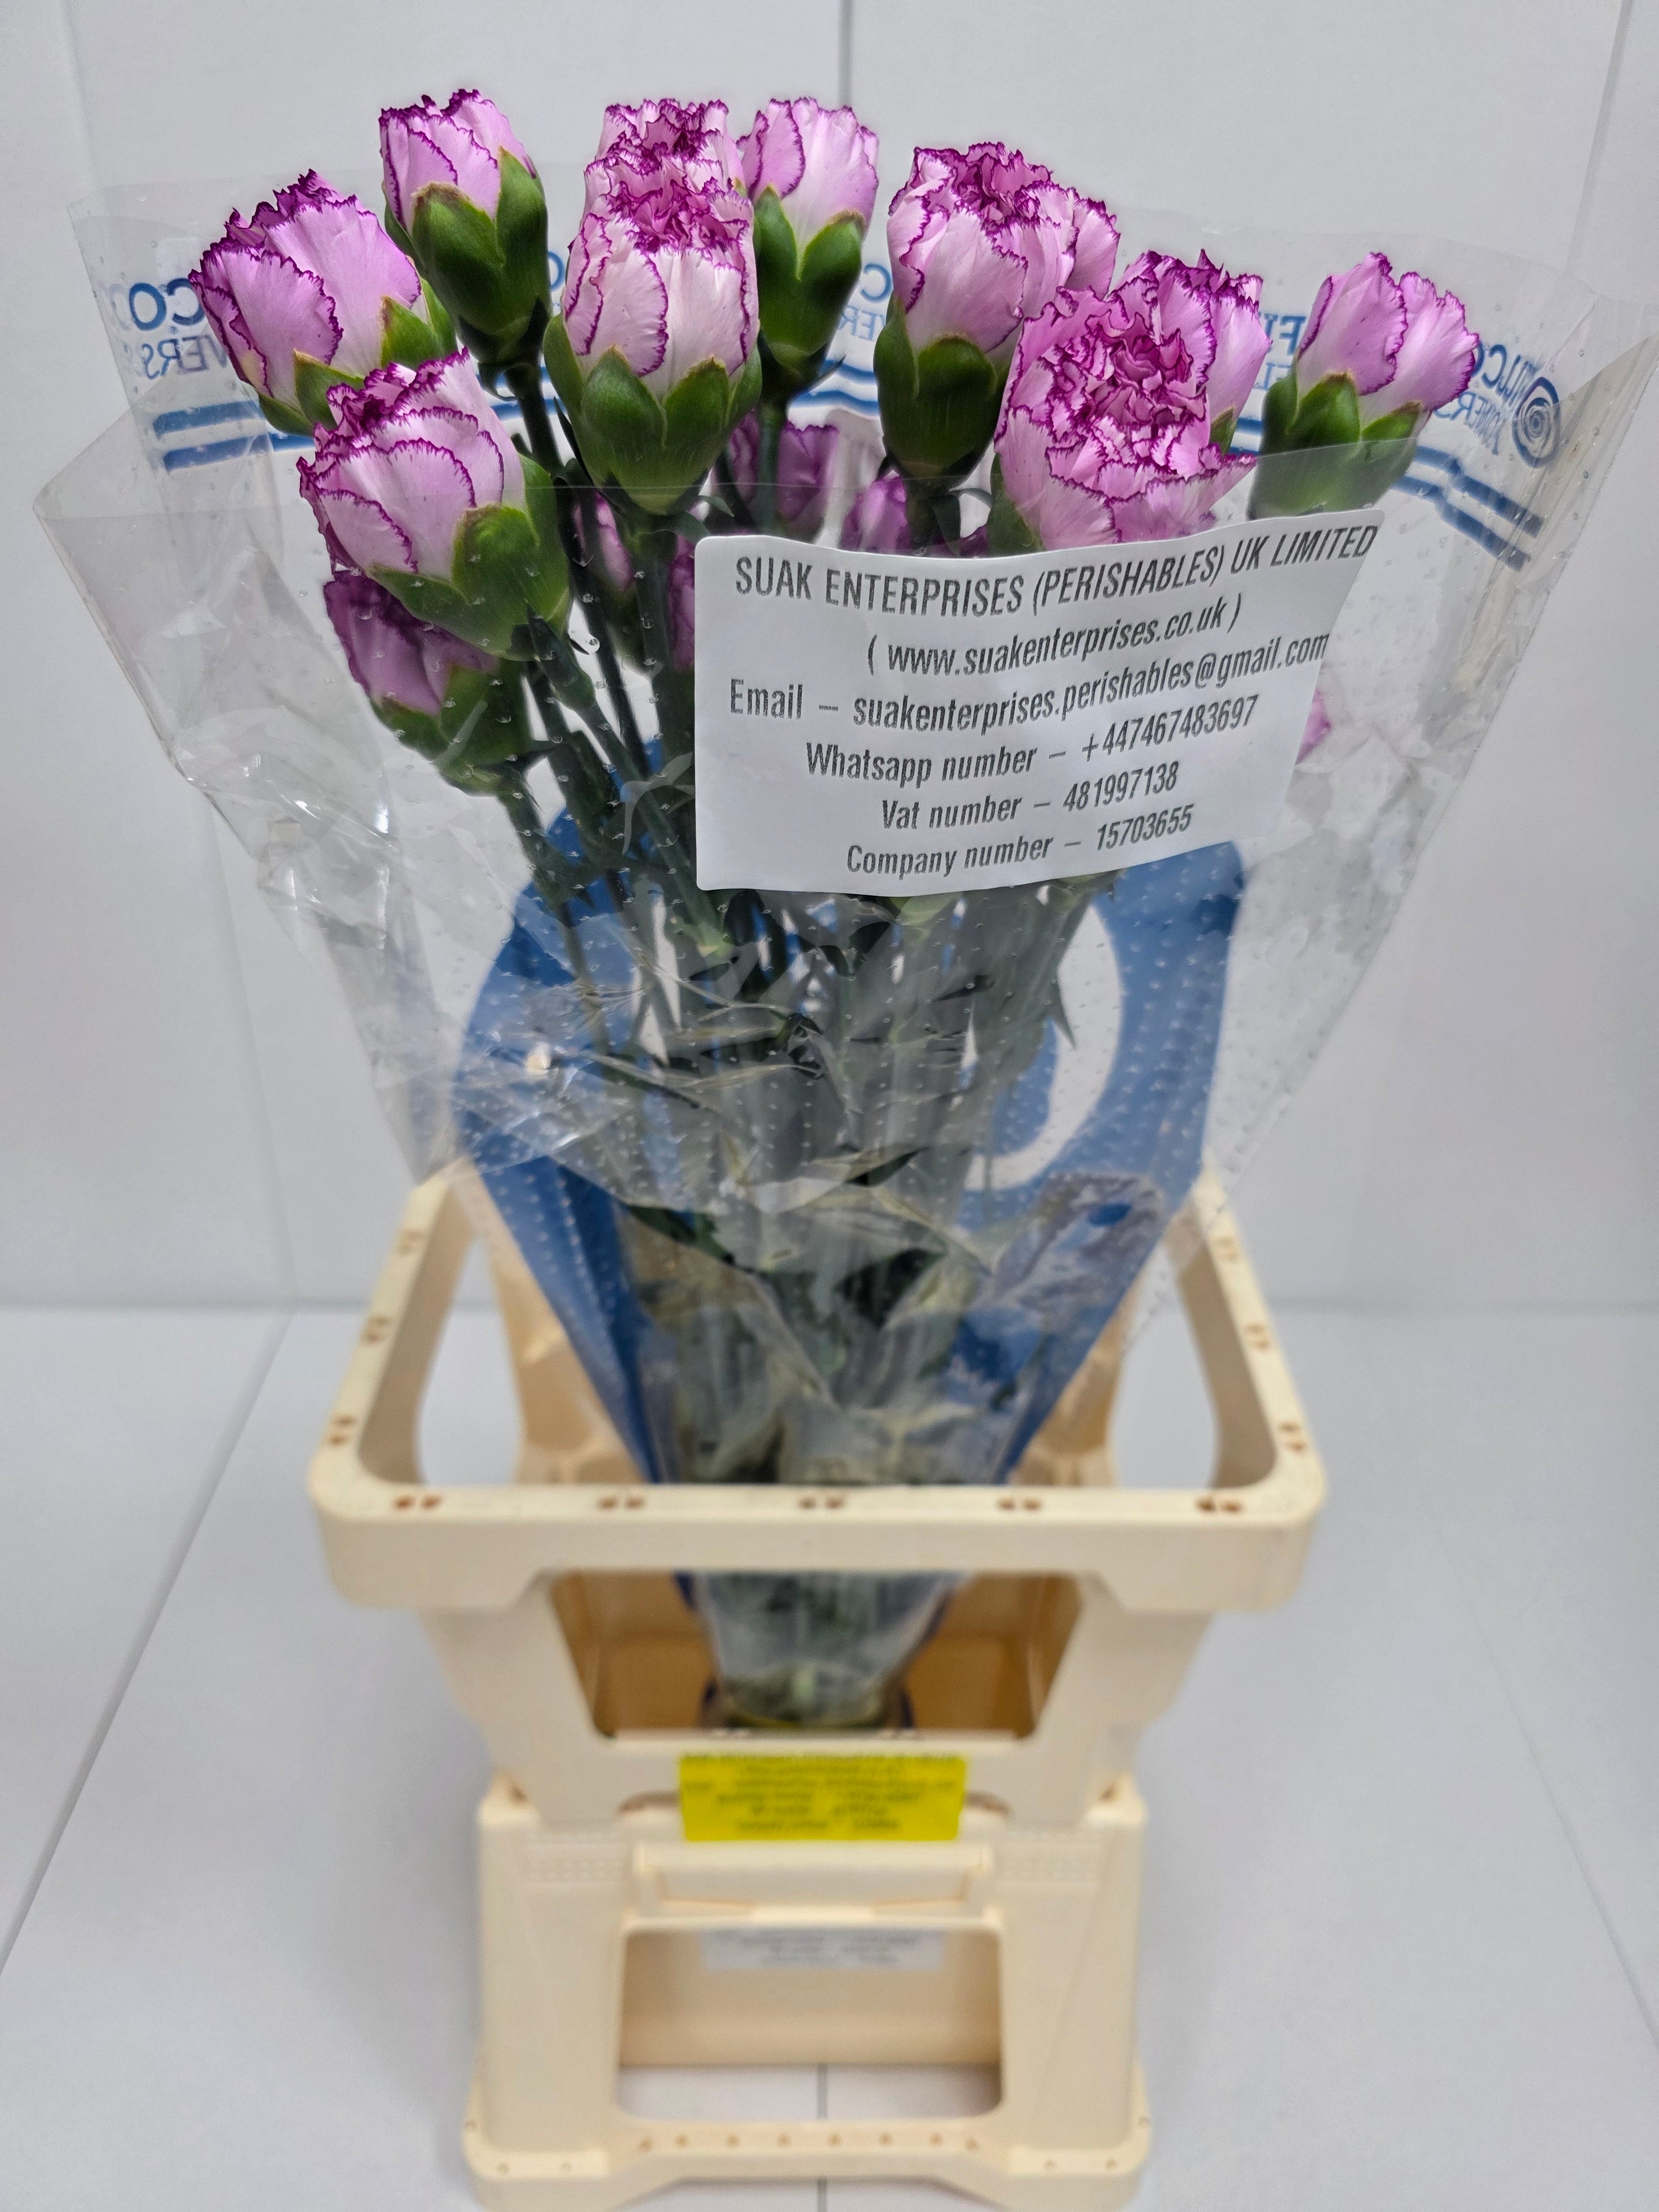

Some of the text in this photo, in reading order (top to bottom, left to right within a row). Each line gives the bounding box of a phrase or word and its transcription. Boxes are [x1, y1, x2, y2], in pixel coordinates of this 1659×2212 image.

[735, 524, 1380, 618] SUAK ENTERPRISES (PERISHABLES) UK LIMITED
[887, 596, 1228, 676] www.suakenterprises.co.uk
[730, 678, 804, 720] Email
[853, 633, 1331, 737] suakenterprises.perishables@gmail.com
[805, 741, 933, 789] Whatsapp
[941, 745, 1039, 782] number
[1081, 693, 1260, 763] +447467483697
[881, 799, 921, 831] Vat
[928, 794, 1023, 830] number
[1062, 760, 1180, 812] 481997138
[846, 844, 958, 881] Company
[963, 835, 1055, 869] number
[1097, 802, 1195, 852] 15703655
